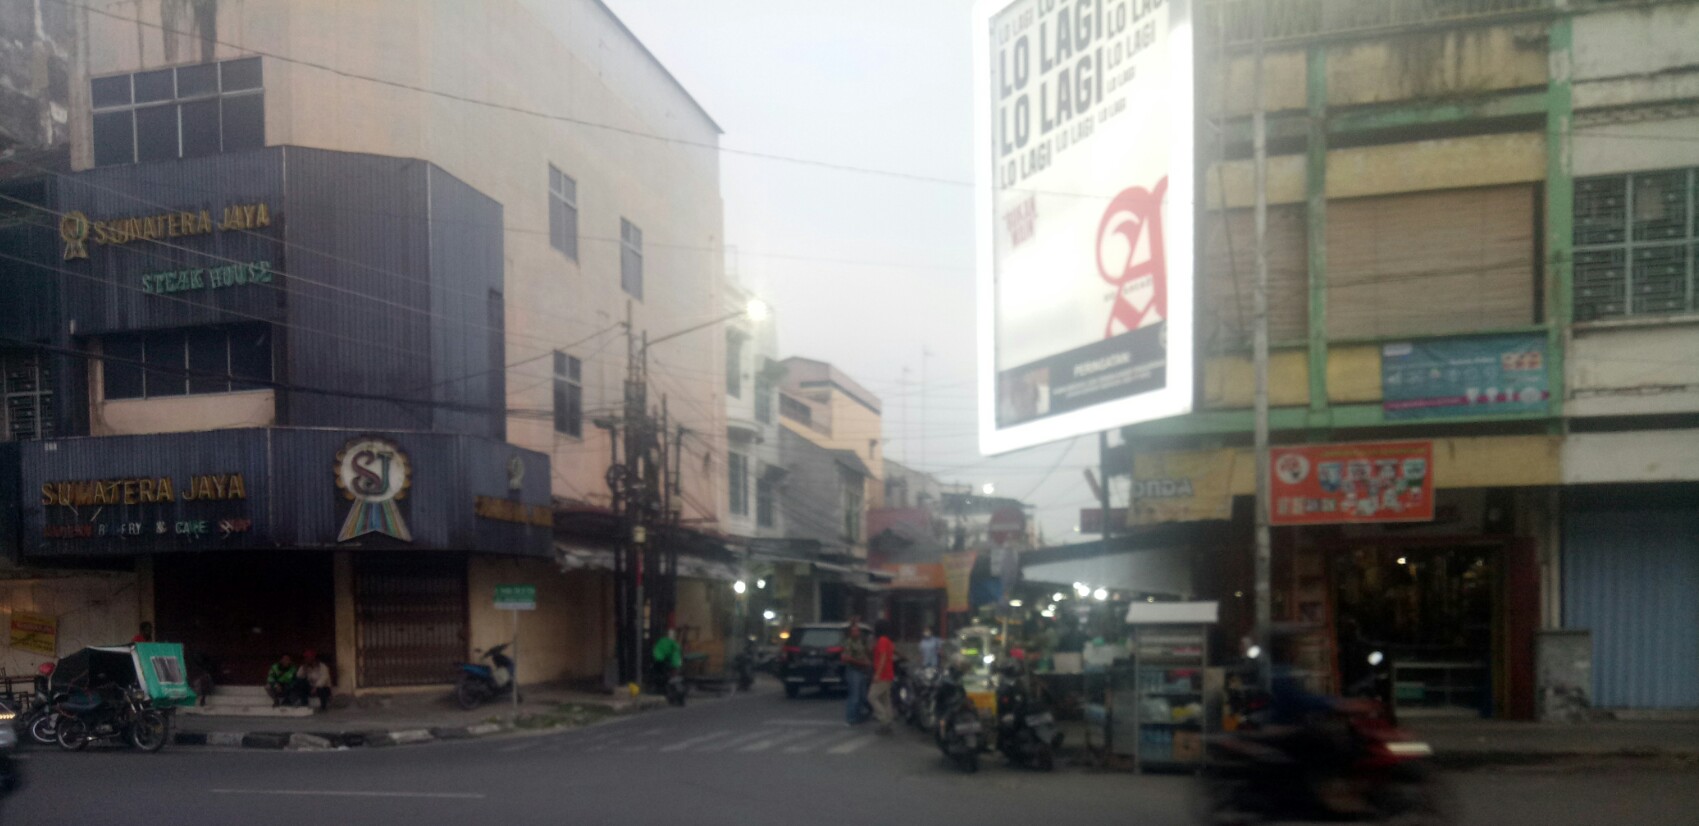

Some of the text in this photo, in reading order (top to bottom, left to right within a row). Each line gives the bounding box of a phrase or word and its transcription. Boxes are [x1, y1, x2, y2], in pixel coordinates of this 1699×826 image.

[1107, 2, 1126, 39] LO
[1001, 0, 1103, 100] LO LAGI
[1001, 46, 1104, 158] LO LAGI
[1001, 159, 1017, 190] LO
[1021, 139, 1051, 181] LAGI
[94, 211, 212, 244] SUMATERA
[217, 202, 271, 231] JAYA
[142, 260, 272, 294] STEAK HOUSE
[182, 473, 246, 500] JAYA
